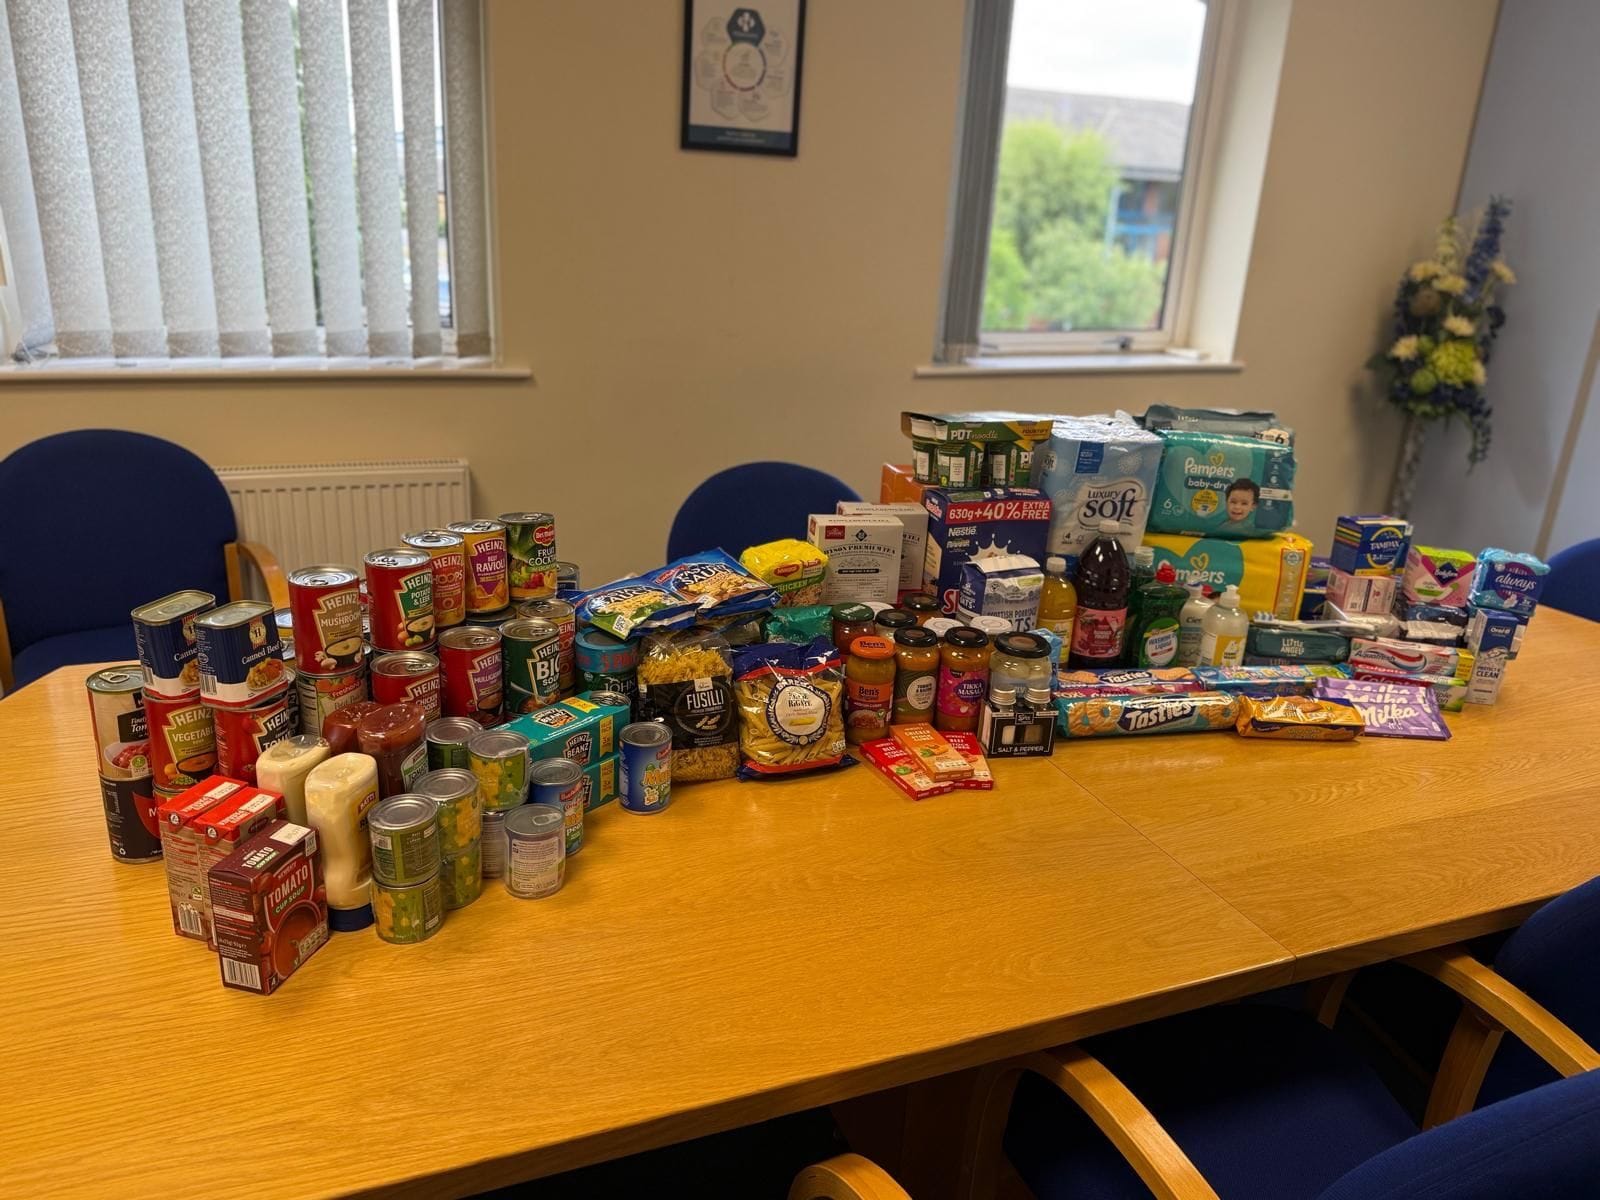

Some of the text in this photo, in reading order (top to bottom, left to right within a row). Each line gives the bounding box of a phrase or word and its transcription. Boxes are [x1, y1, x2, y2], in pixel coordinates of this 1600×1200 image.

[951, 429, 972, 441] POT
[1184, 457, 1236, 478] Pampers
[1188, 477, 1228, 492] baby-dry
[1022, 501, 1050, 510] EXTRA
[1083, 488, 1137, 521] soft
[1021, 510, 1049, 520] FREE
[476, 540, 507, 553] HEINZ
[1495, 573, 1537, 591] always
[325, 594, 358, 610] HEINZ
[242, 647, 266, 665] Canned
[1105, 671, 1150, 684] Tasties
[686, 690, 725, 710] FUSILLI
[858, 686, 880, 696] Ben's
[1124, 701, 1193, 731] Tasties
[1354, 703, 1420, 728] Milka
[566, 744, 589, 757] BEANZ
[241, 846, 274, 868] TOMATO
[269, 865, 309, 907] TOMATO
[275, 886, 305, 913] CUP SOUP
